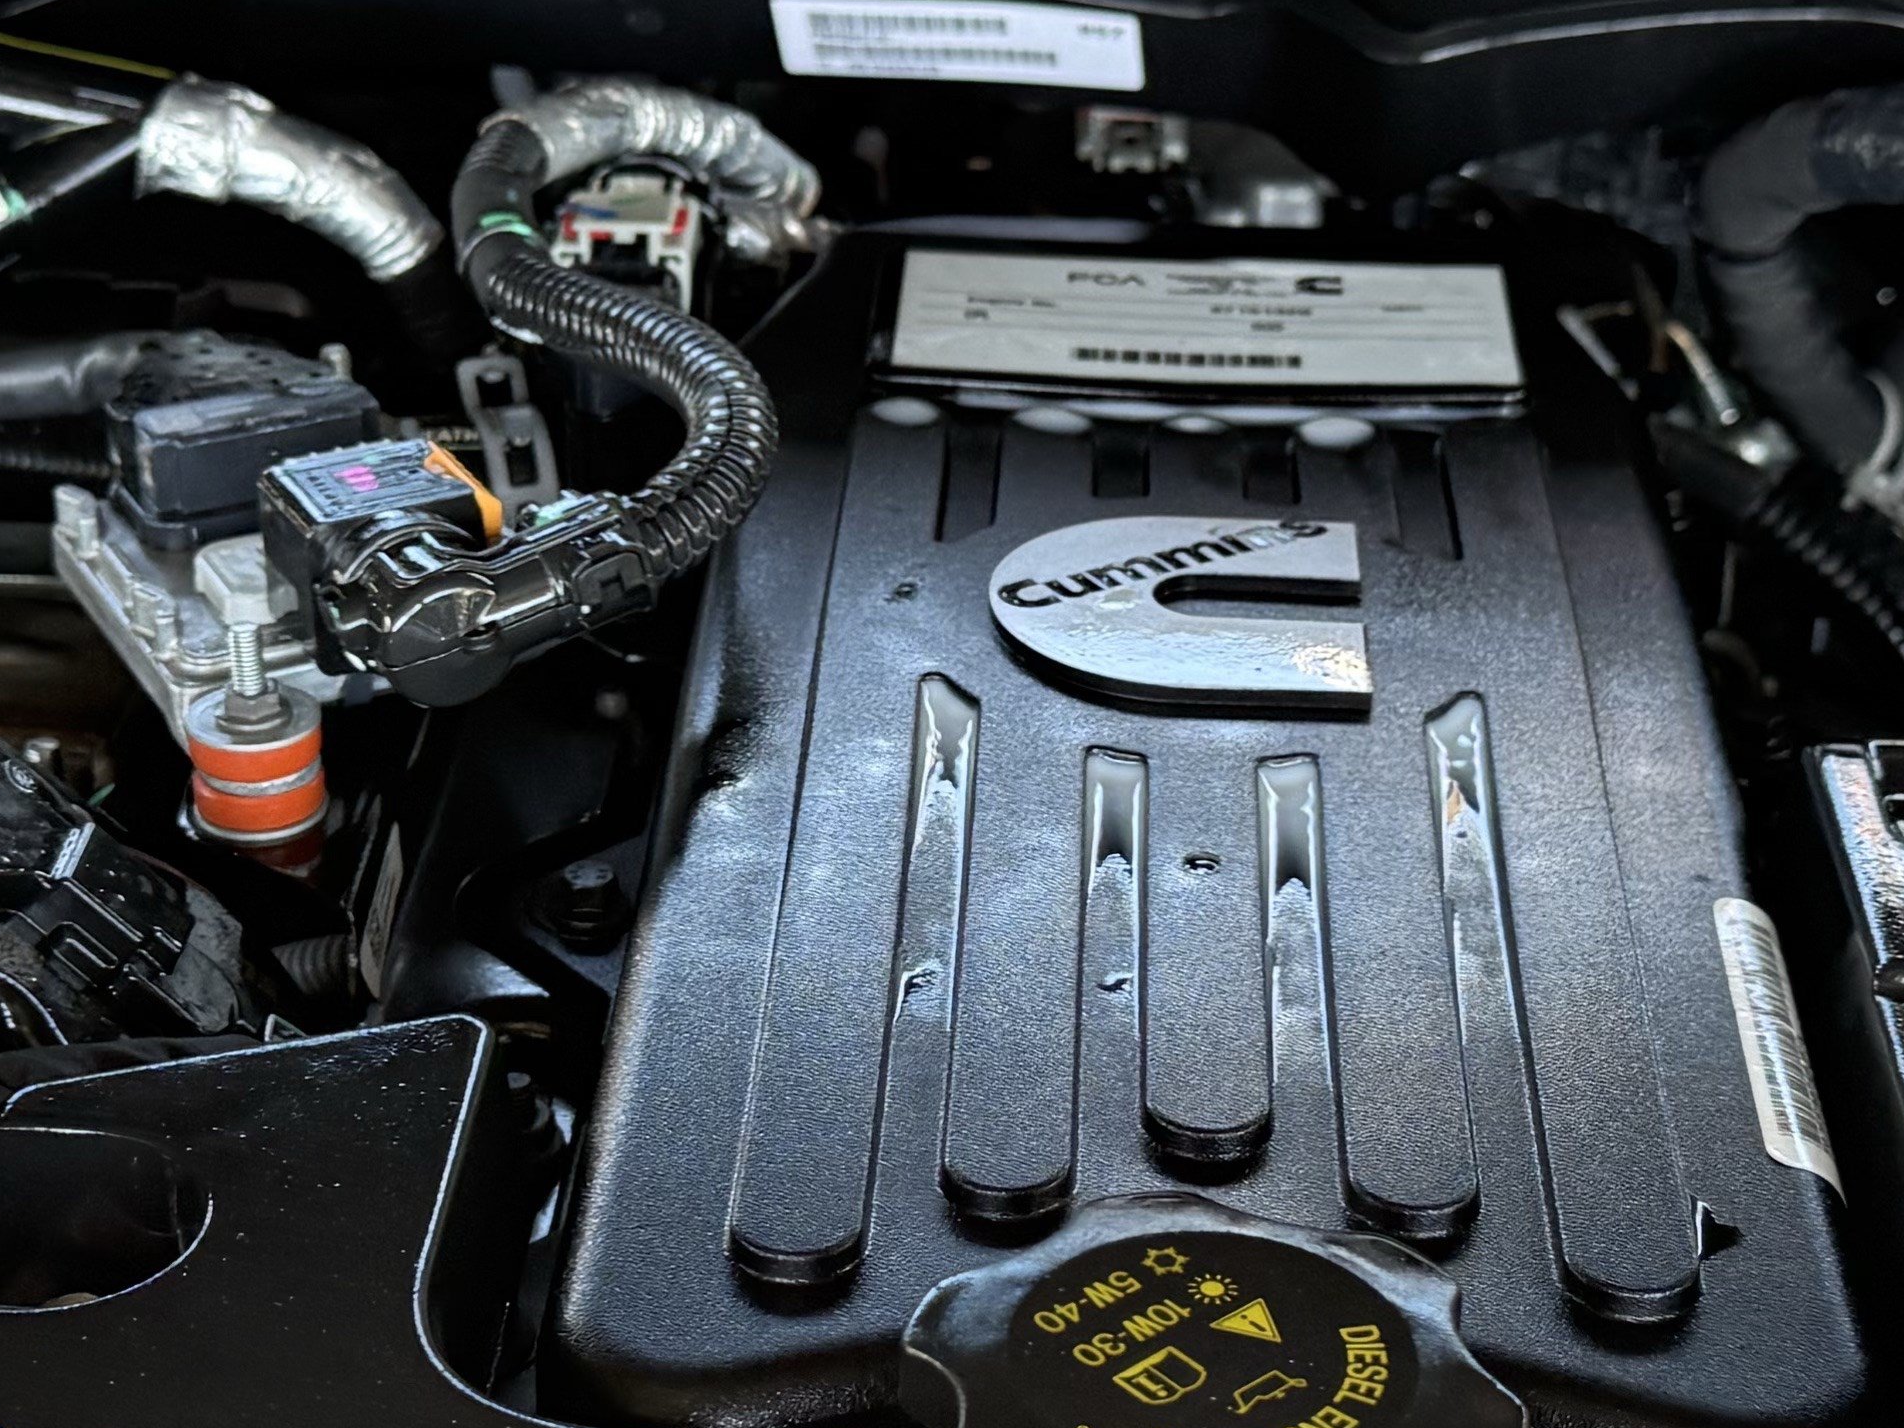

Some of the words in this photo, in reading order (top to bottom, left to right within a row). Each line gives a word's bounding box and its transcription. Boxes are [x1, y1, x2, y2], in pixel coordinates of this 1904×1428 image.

[997, 519, 1328, 608] Cummins
[1033, 1270, 1142, 1335] 5W-40
[1072, 1299, 1192, 1369] 10W-30
[1333, 1324, 1390, 1406] DIESEL
